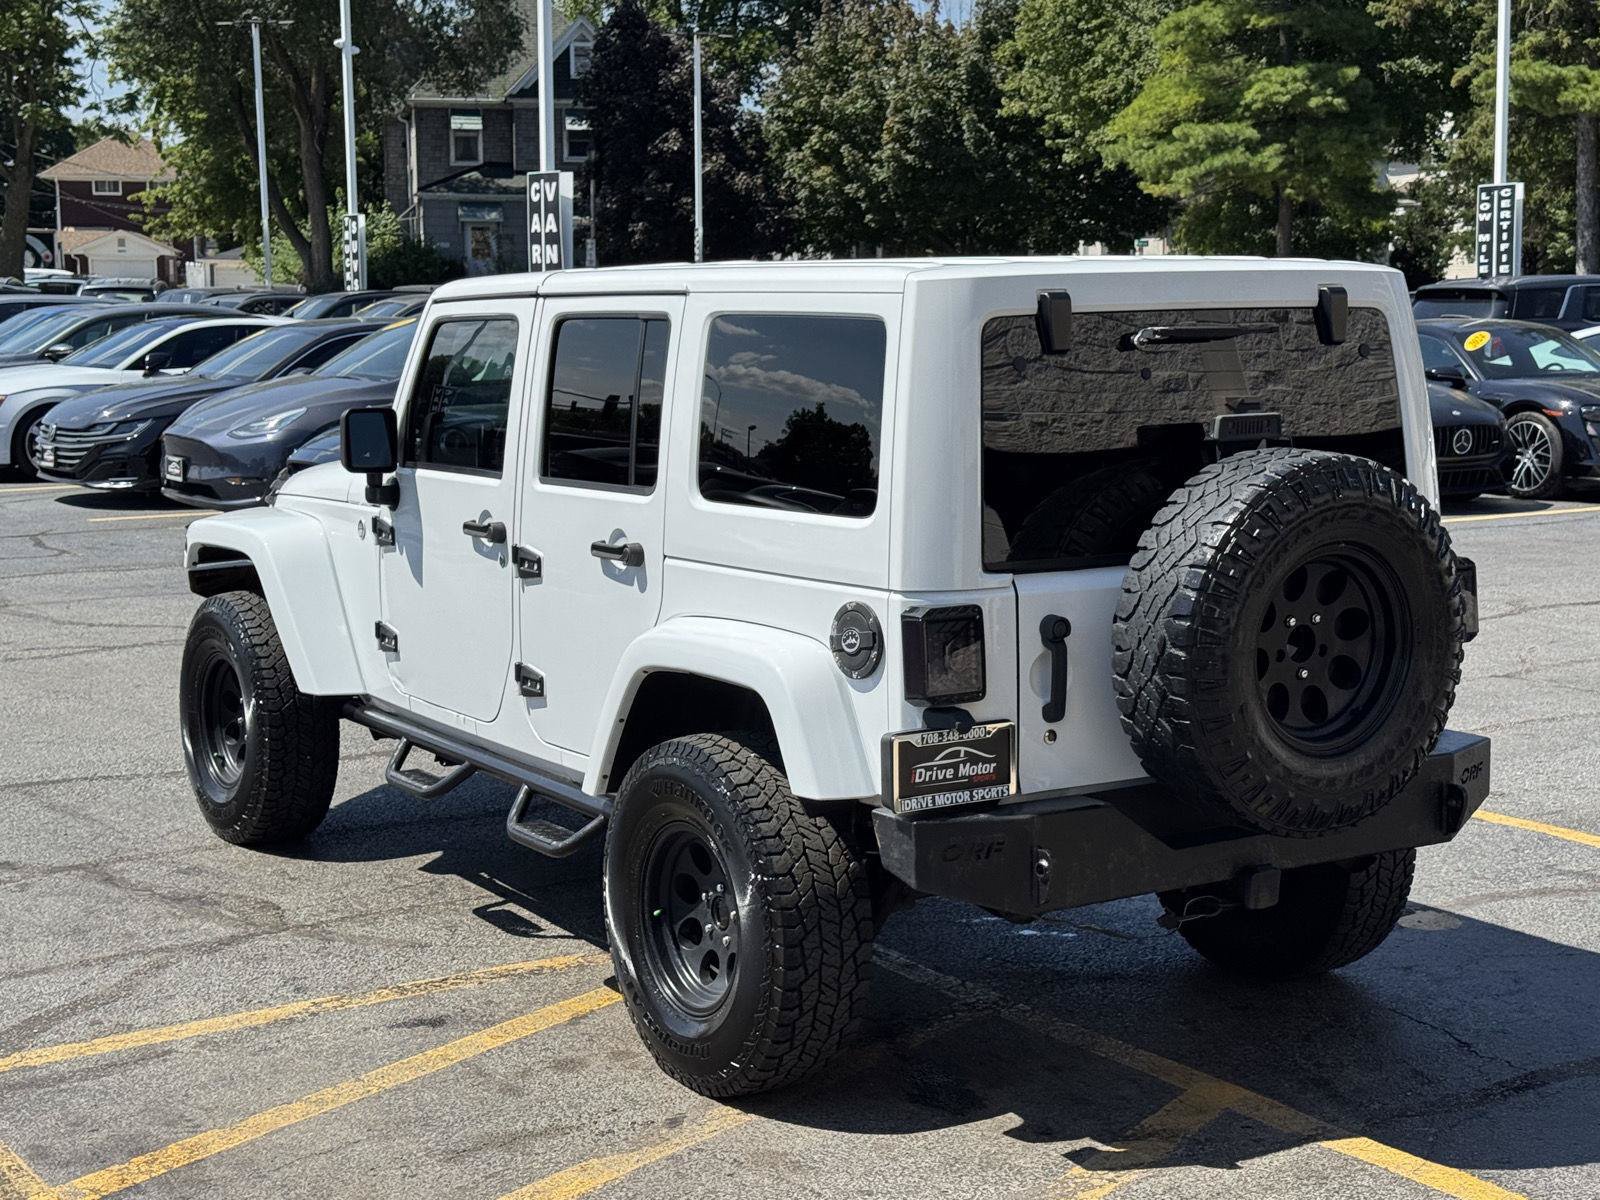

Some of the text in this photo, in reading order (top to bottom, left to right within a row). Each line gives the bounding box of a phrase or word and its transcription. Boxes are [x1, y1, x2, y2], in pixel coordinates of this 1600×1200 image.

[530, 181, 542, 264] CAR
[544, 181, 559, 264] VAN
[1478, 191, 1492, 222] LOW
[351, 220, 360, 291] SUVS
[958, 762, 997, 777] Motor
[935, 790, 970, 806] MOTOR
[972, 785, 1008, 801] SPORTS
